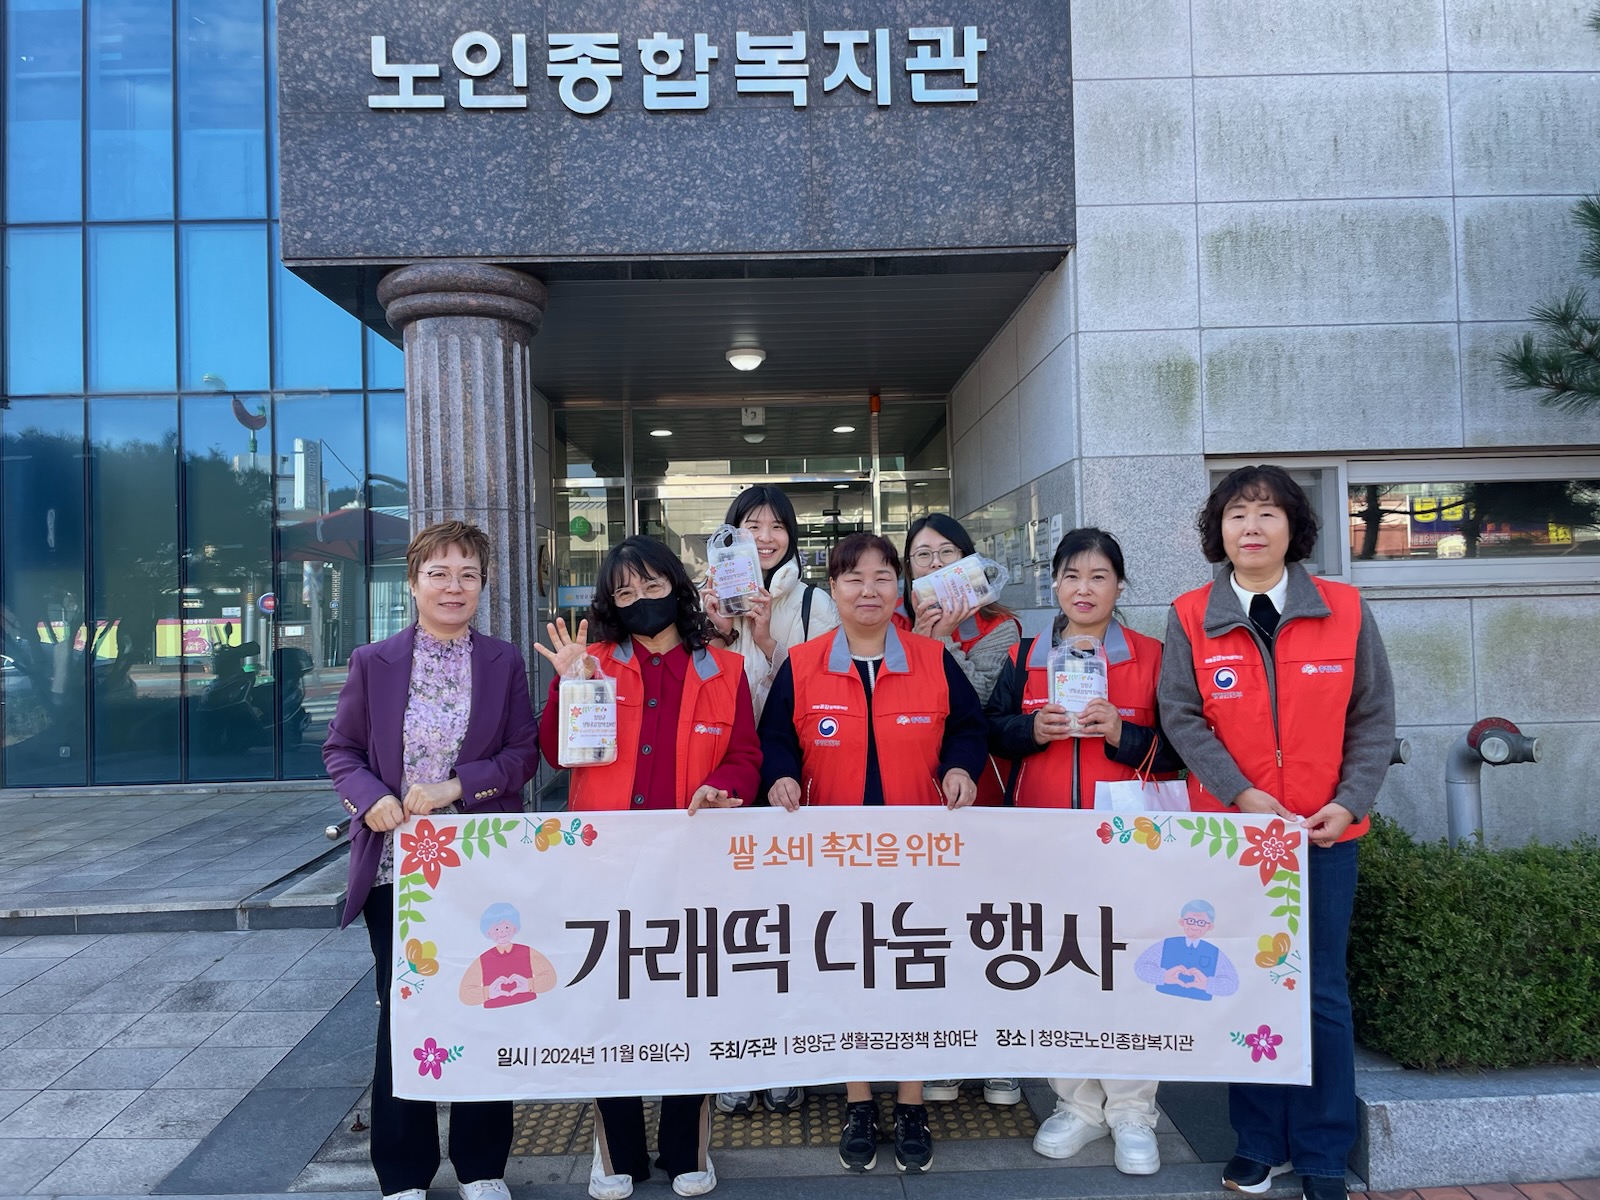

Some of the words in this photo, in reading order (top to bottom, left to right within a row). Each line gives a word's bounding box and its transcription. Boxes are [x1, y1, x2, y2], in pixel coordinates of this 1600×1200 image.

[367, 25, 988, 115] 노인종합복지관
[727, 834, 758, 871] 쌀
[762, 832, 813, 867] 소비
[820, 831, 900, 867] 촉진을
[905, 832, 965, 867] 위한
[563, 903, 791, 1000] 가래떡
[813, 901, 954, 991] 나눔
[966, 901, 1128, 992] 행사
[497, 1047, 528, 1067] 일시
[541, 1046, 595, 1065] 2024년
[600, 1044, 634, 1063] 11월
[639, 1042, 690, 1063] 6일(수)
[709, 1037, 778, 1061] 주최/주관
[792, 1033, 836, 1054] 청양군
[840, 1031, 929, 1050] 생활공감정책
[933, 1029, 978, 1049] 참여단
[995, 1029, 1026, 1047] 장소
[1038, 1030, 1195, 1052] 청양군노인종합복지관
